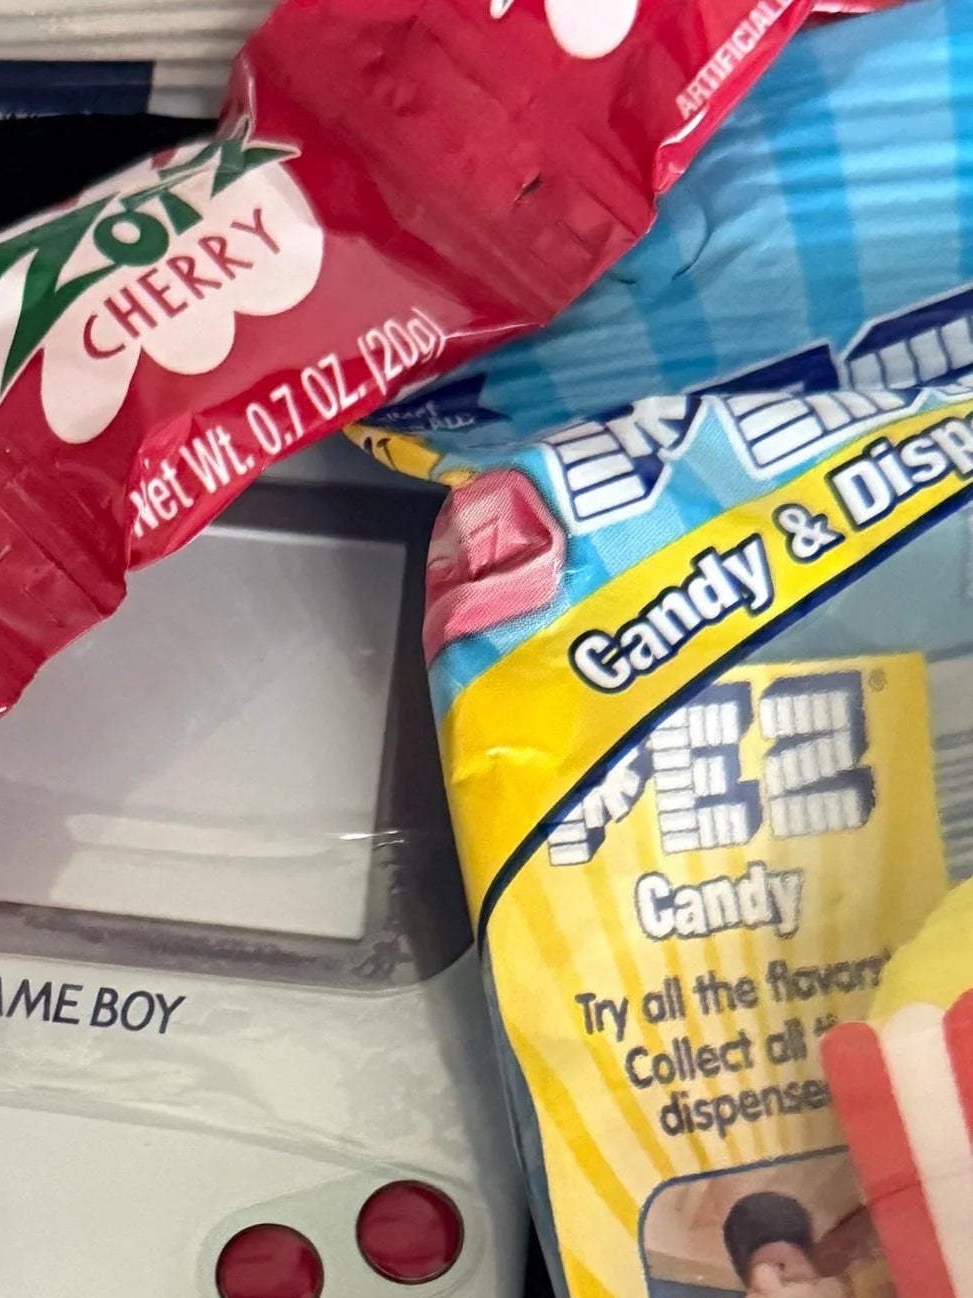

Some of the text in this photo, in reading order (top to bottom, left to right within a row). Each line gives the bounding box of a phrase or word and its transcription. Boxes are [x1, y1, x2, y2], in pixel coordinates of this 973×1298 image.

[83, 207, 281, 360] CHERRY
[179, 426, 256, 494] Wt.
[246, 384, 305, 454] 0.7
[301, 353, 367, 420] OZ.
[570, 412, 973, 693] Candy & Disp
[635, 860, 804, 941] Candy
[90, 987, 187, 1034] BOY
[574, 992, 630, 1042] Try
[642, 974, 686, 1024] all
[692, 970, 760, 1015] the
[625, 1031, 755, 1089] Collect
[765, 1017, 808, 1065] all
[659, 1080, 831, 1140] dispense
